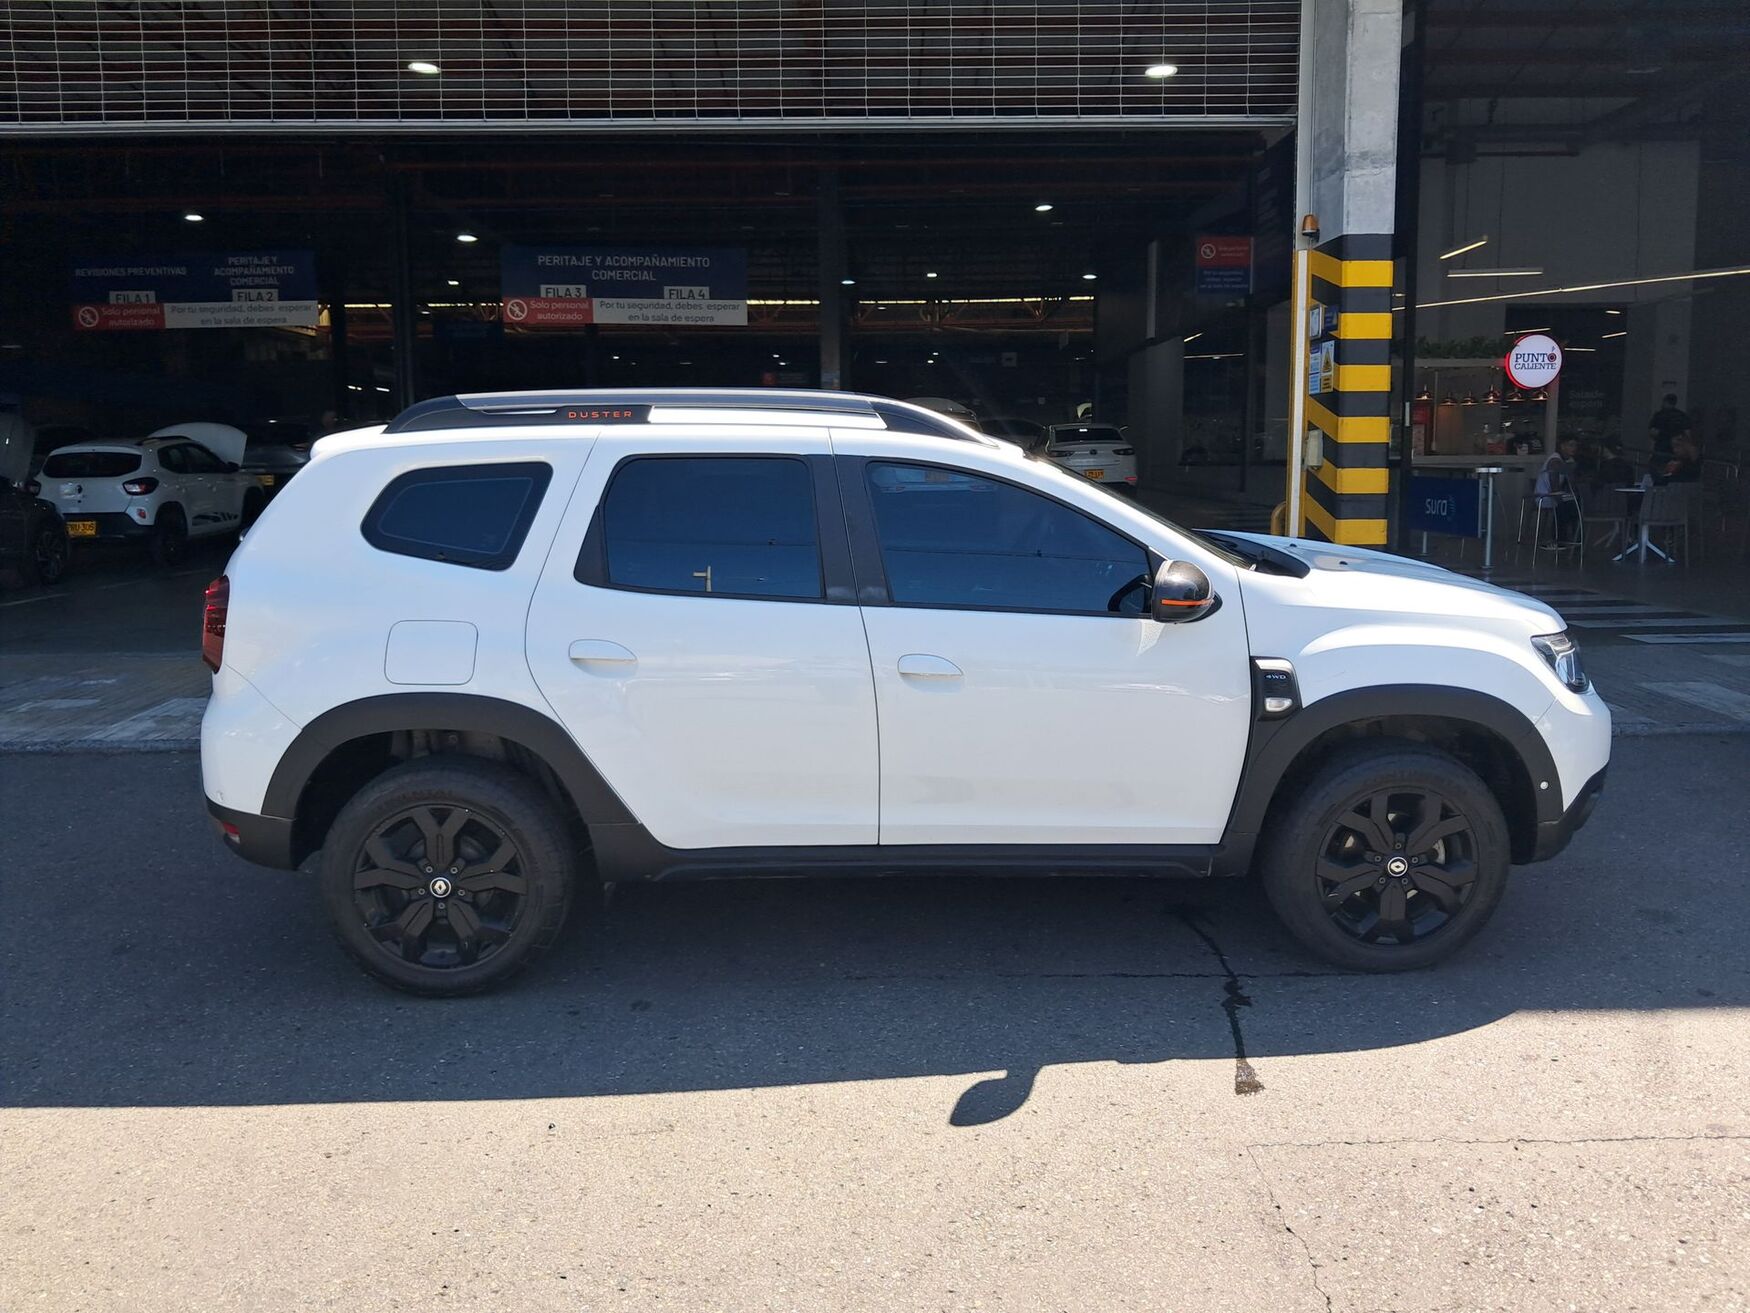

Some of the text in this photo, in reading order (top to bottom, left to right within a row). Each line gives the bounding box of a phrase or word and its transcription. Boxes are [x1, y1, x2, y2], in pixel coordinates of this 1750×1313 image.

[228, 256, 271, 265] PERITAJE
[537, 254, 711, 268] PERITAJE Y ACOMPAÑAMIENTO
[127, 266, 187, 276] PREVENTIVAS
[592, 270, 657, 281] COMERCIAL
[230, 276, 280, 286] COMERCIAL
[237, 291, 273, 302] FILA 2
[545, 287, 582, 298] FILA 3
[668, 288, 705, 300] FILA 4
[115, 293, 150, 304] FILA 1
[529, 301, 589, 311] Solo personal
[600, 300, 614, 309] Por
[675, 301, 703, 310] debes
[706, 302, 741, 311] esperar
[537, 311, 583, 320] autorizado
[671, 313, 683, 322] de
[684, 314, 714, 323] espera
[1514, 352, 1557, 363] PUNTO
[1514, 362, 1557, 370] CALIENTE
[567, 410, 633, 419] DUSTER
[1424, 497, 1448, 516] sura
